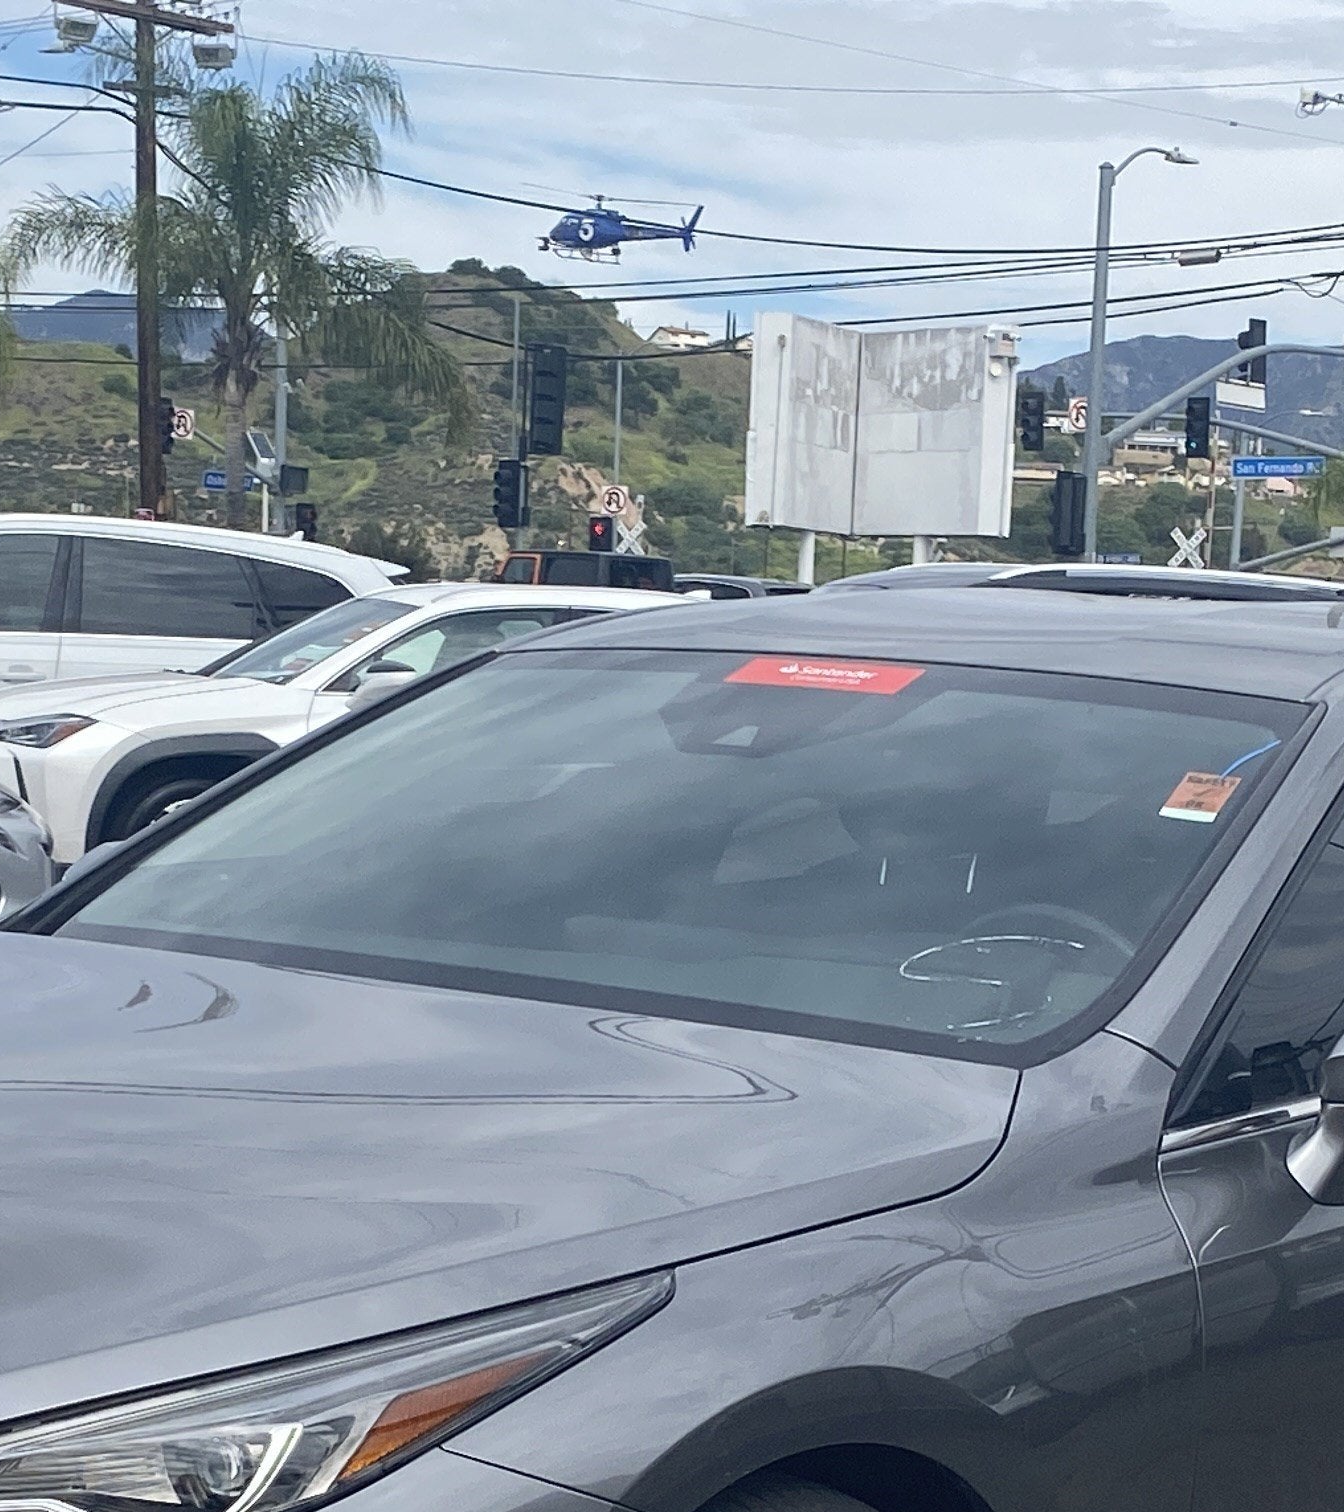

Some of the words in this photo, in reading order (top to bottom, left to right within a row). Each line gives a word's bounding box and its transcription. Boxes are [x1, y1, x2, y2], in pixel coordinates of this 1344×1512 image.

[578, 218, 595, 242] 5
[1236, 462, 1255, 474] San
[1257, 462, 1304, 474] Fernando
[798, 666, 878, 679] Santander
